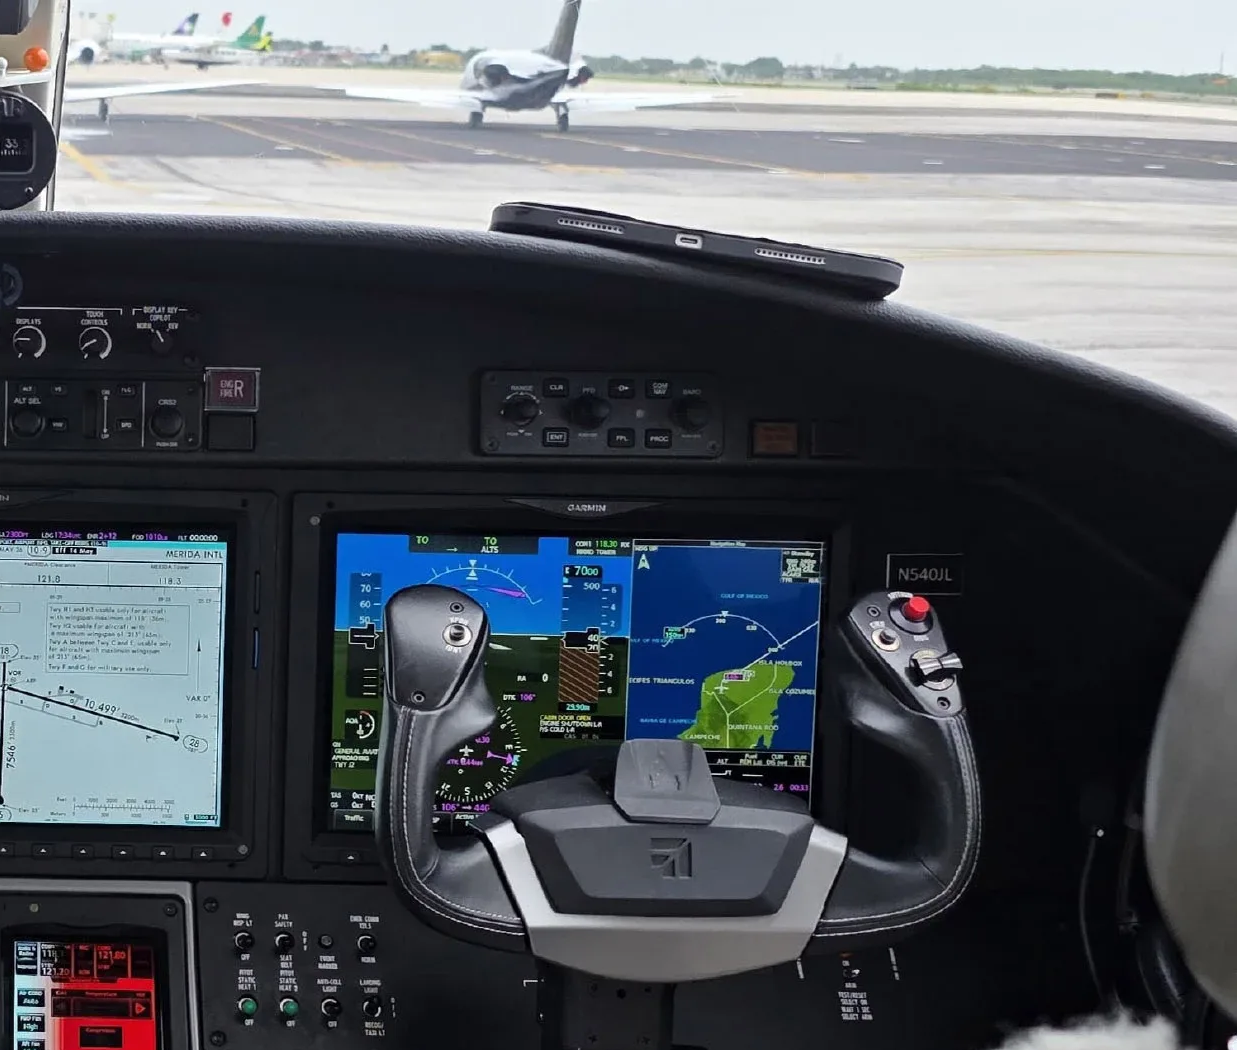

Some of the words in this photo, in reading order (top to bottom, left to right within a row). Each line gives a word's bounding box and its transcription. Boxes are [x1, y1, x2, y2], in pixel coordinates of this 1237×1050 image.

[567, 504, 607, 513] GARMIN
[416, 536, 429, 544] TO
[484, 537, 497, 545] TO
[481, 545, 499, 553] ALTS
[165, 550, 201, 559] MERIDA
[204, 551, 224, 560] INTL
[898, 568, 953, 581] N540JL
[159, 577, 183, 585] 118.3
[584, 582, 600, 590] 500
[360, 600, 371, 608] 60
[0, 646, 10, 655] 18
[189, 738, 200, 748] 28
